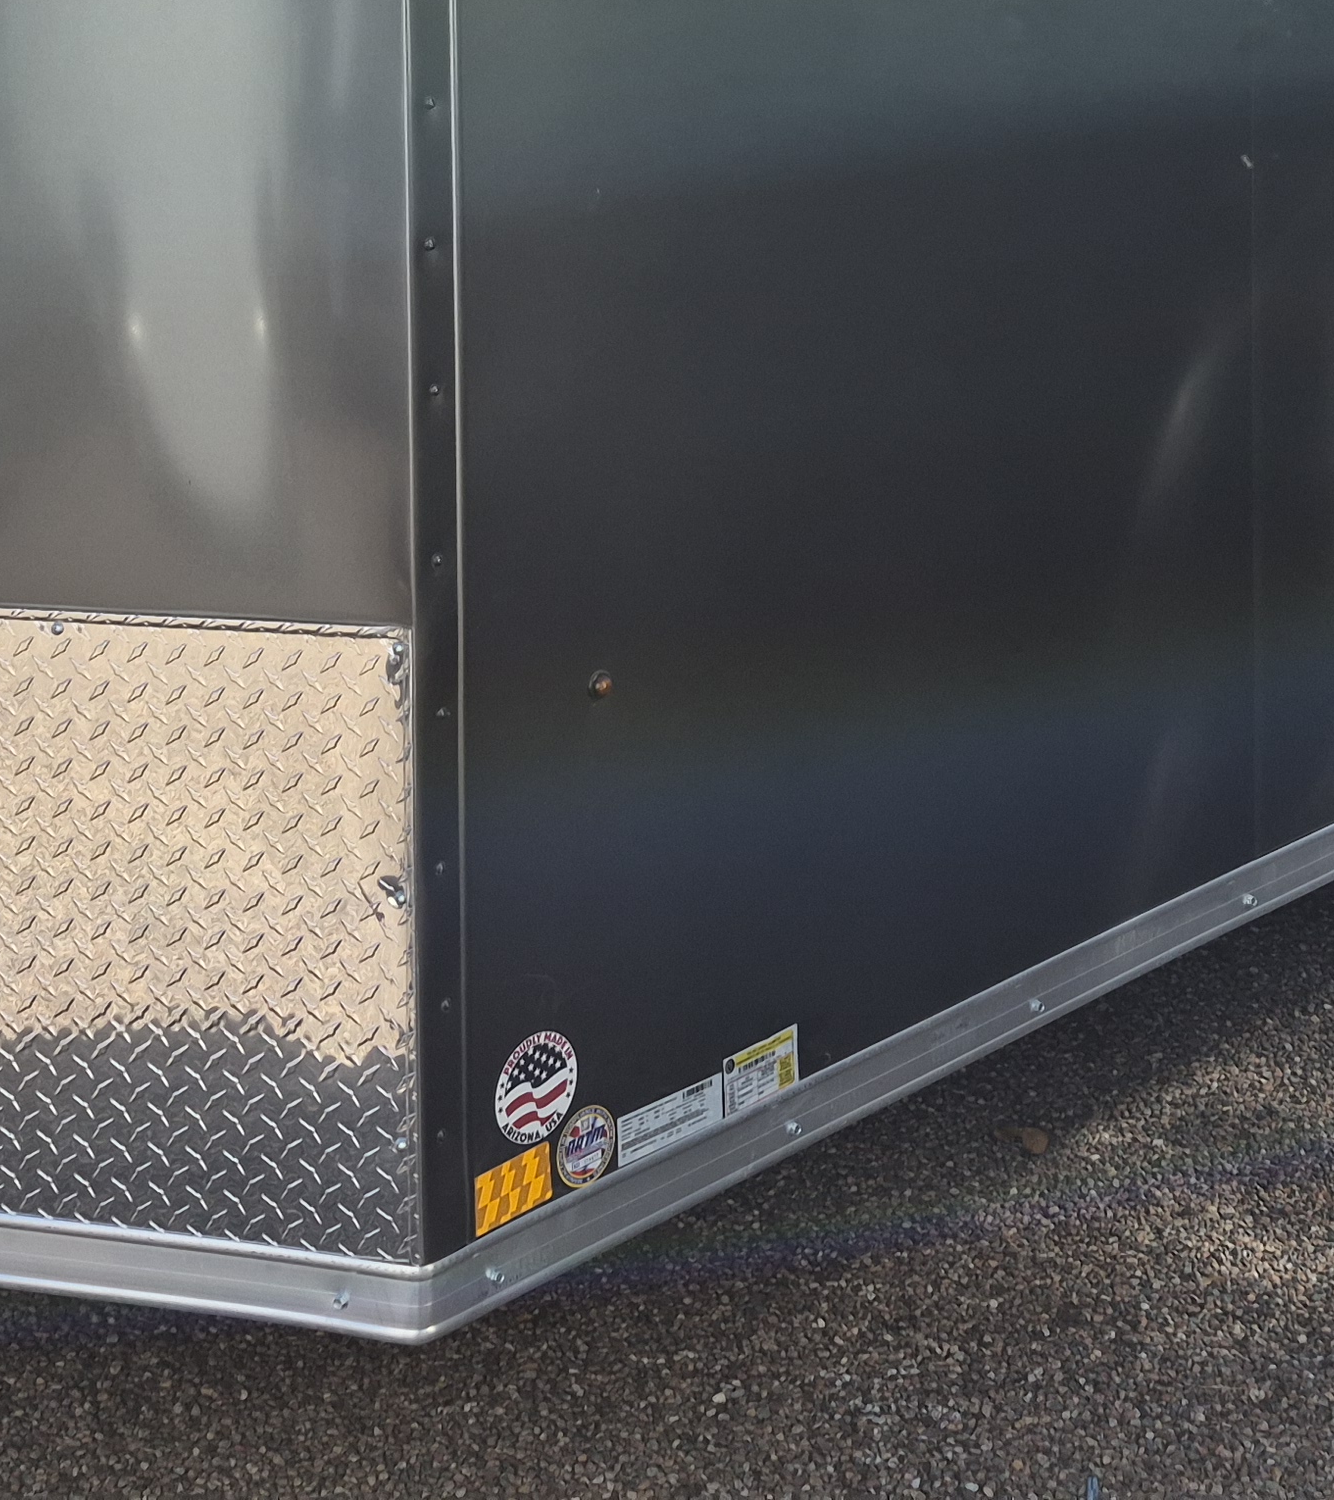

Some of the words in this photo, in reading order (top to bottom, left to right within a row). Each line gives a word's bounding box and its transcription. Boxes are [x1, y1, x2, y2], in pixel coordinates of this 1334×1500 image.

[503, 1033, 543, 1076] PROUDLY
[544, 1032, 567, 1050] MADE
[564, 1046, 574, 1060] IN
[545, 1111, 564, 1132] USA
